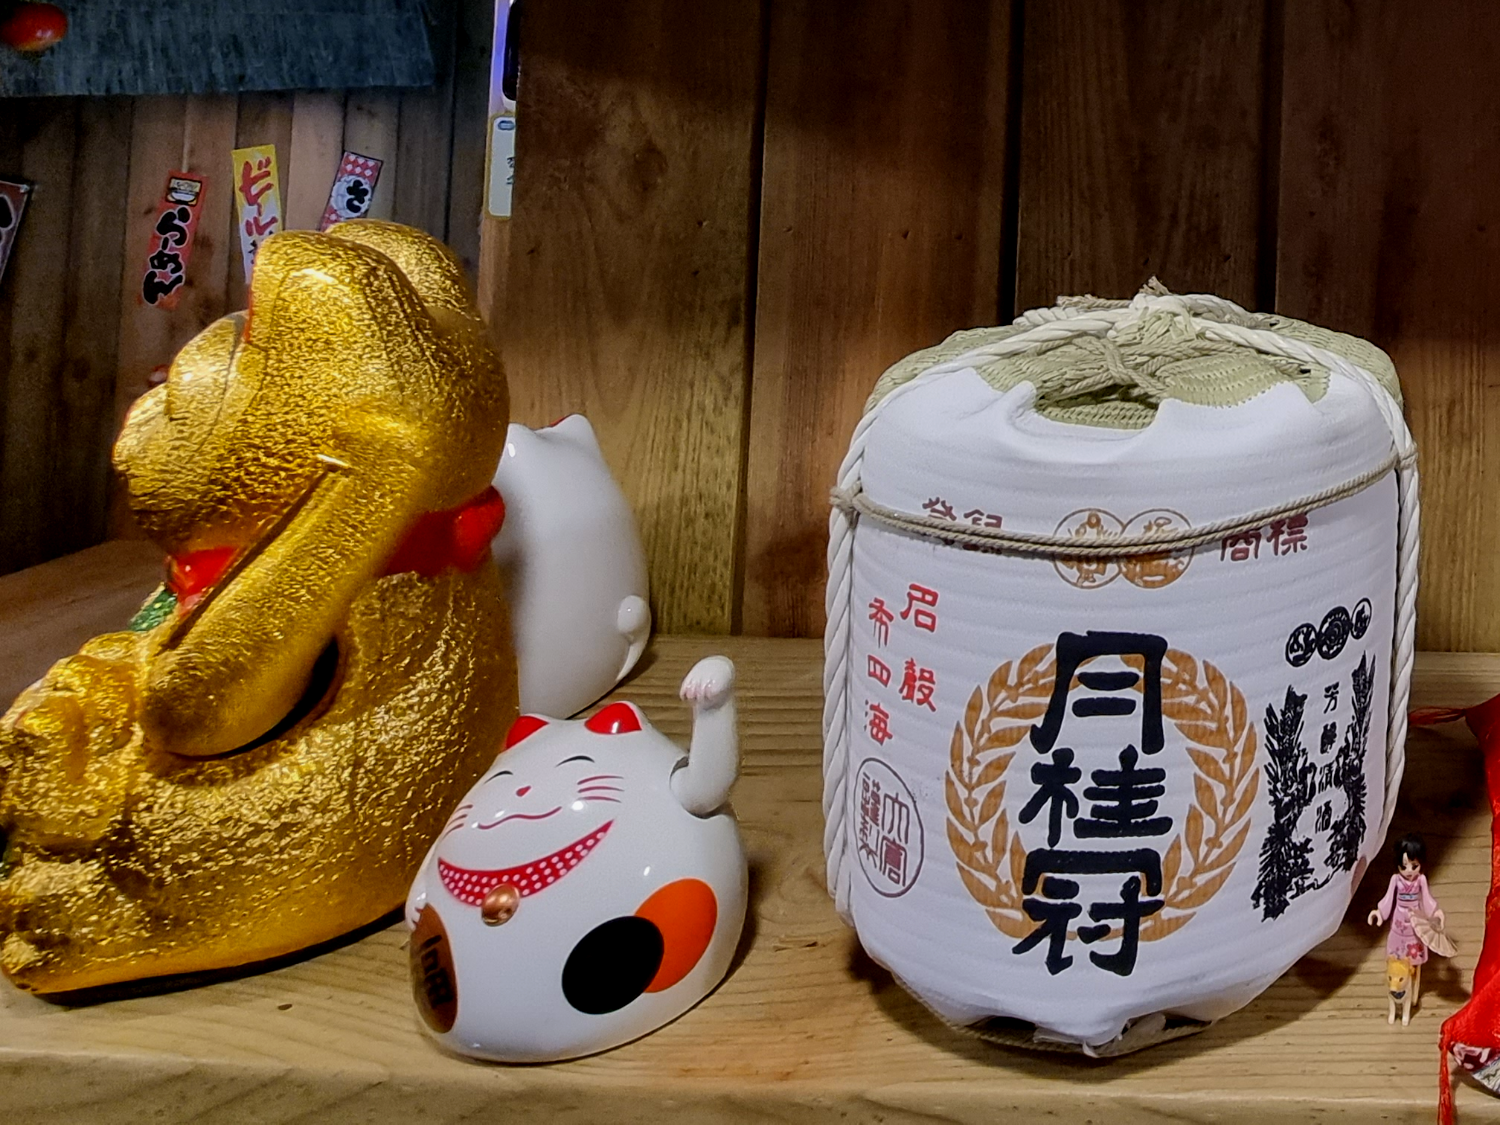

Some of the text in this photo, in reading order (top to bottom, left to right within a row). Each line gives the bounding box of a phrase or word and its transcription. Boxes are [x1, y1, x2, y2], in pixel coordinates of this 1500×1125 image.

[239, 156, 279, 236] ビール
[1012, 629, 1173, 977] 月桂冠
